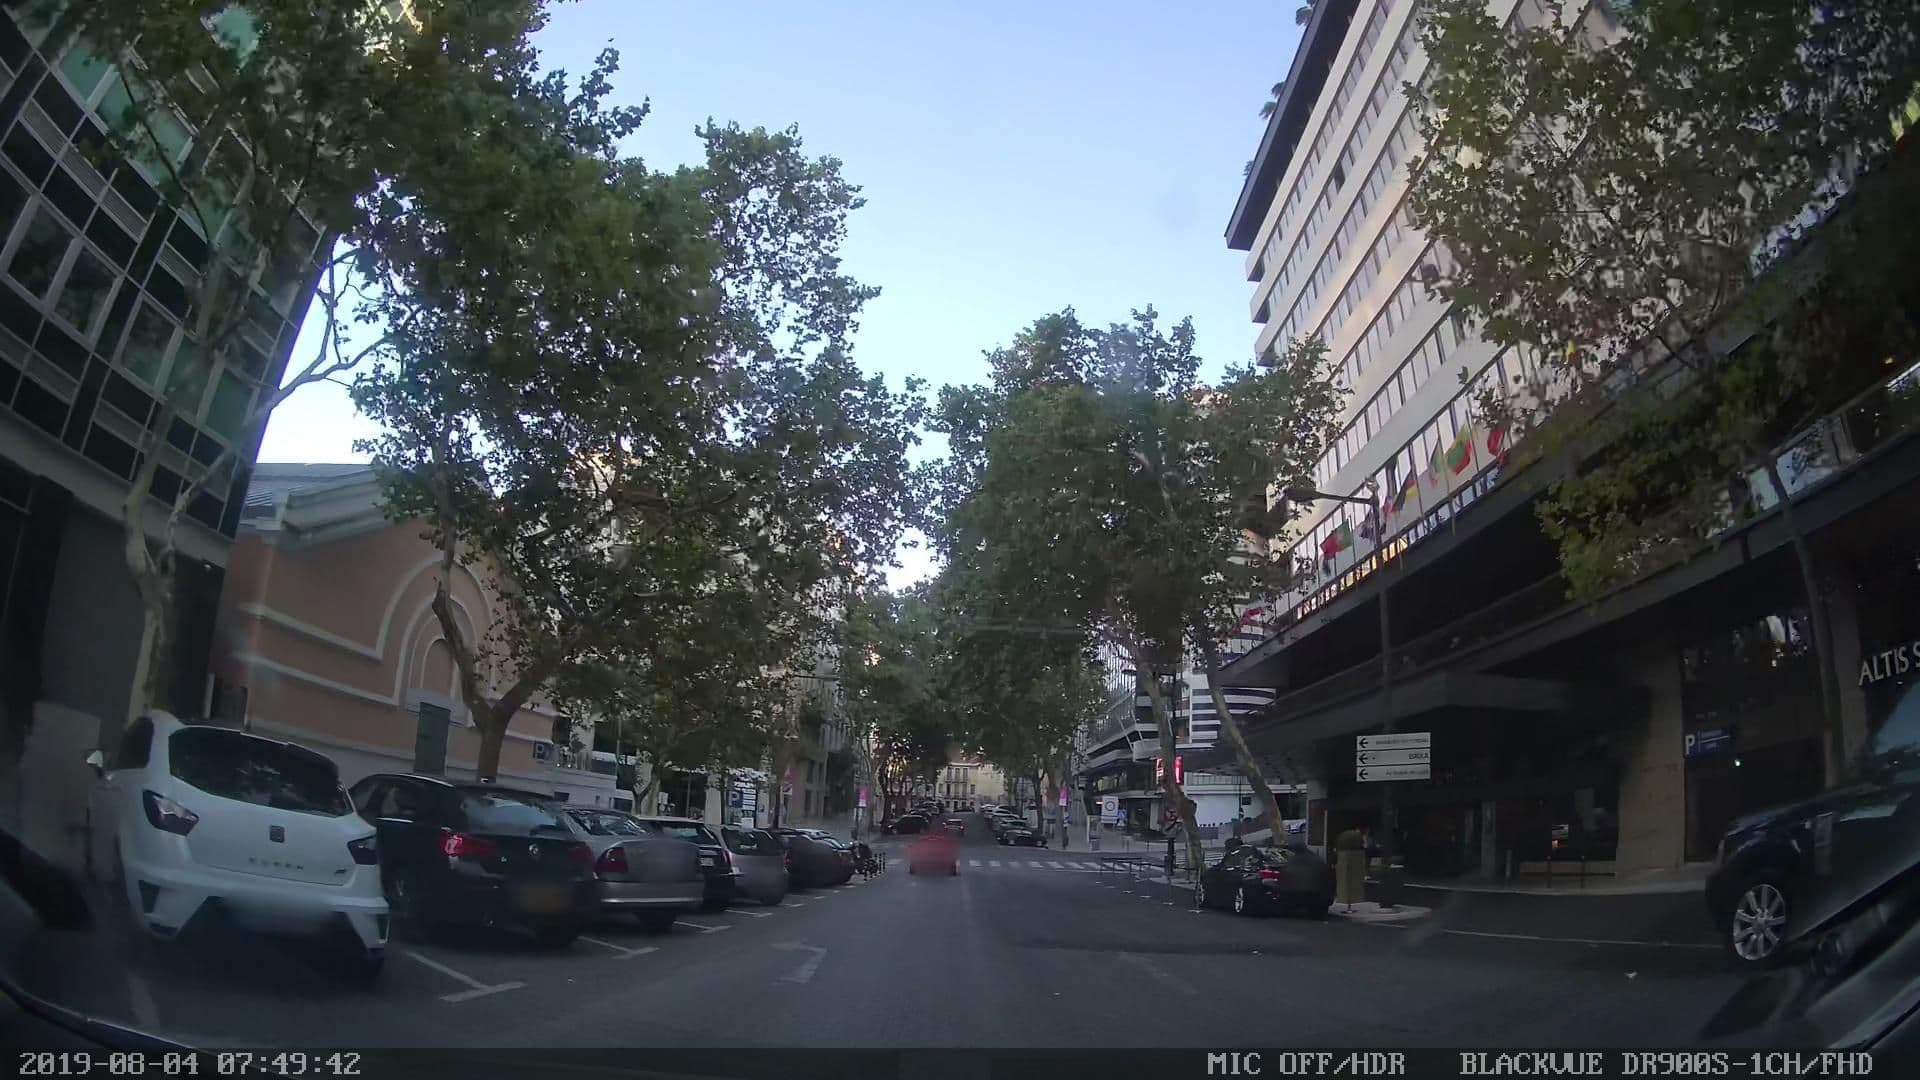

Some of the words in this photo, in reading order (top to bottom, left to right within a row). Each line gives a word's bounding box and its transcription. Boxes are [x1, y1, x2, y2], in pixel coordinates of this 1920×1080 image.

[1858, 646, 1910, 686] ALTIS
[1685, 734, 1696, 755] P
[728, 790, 740, 806] P
